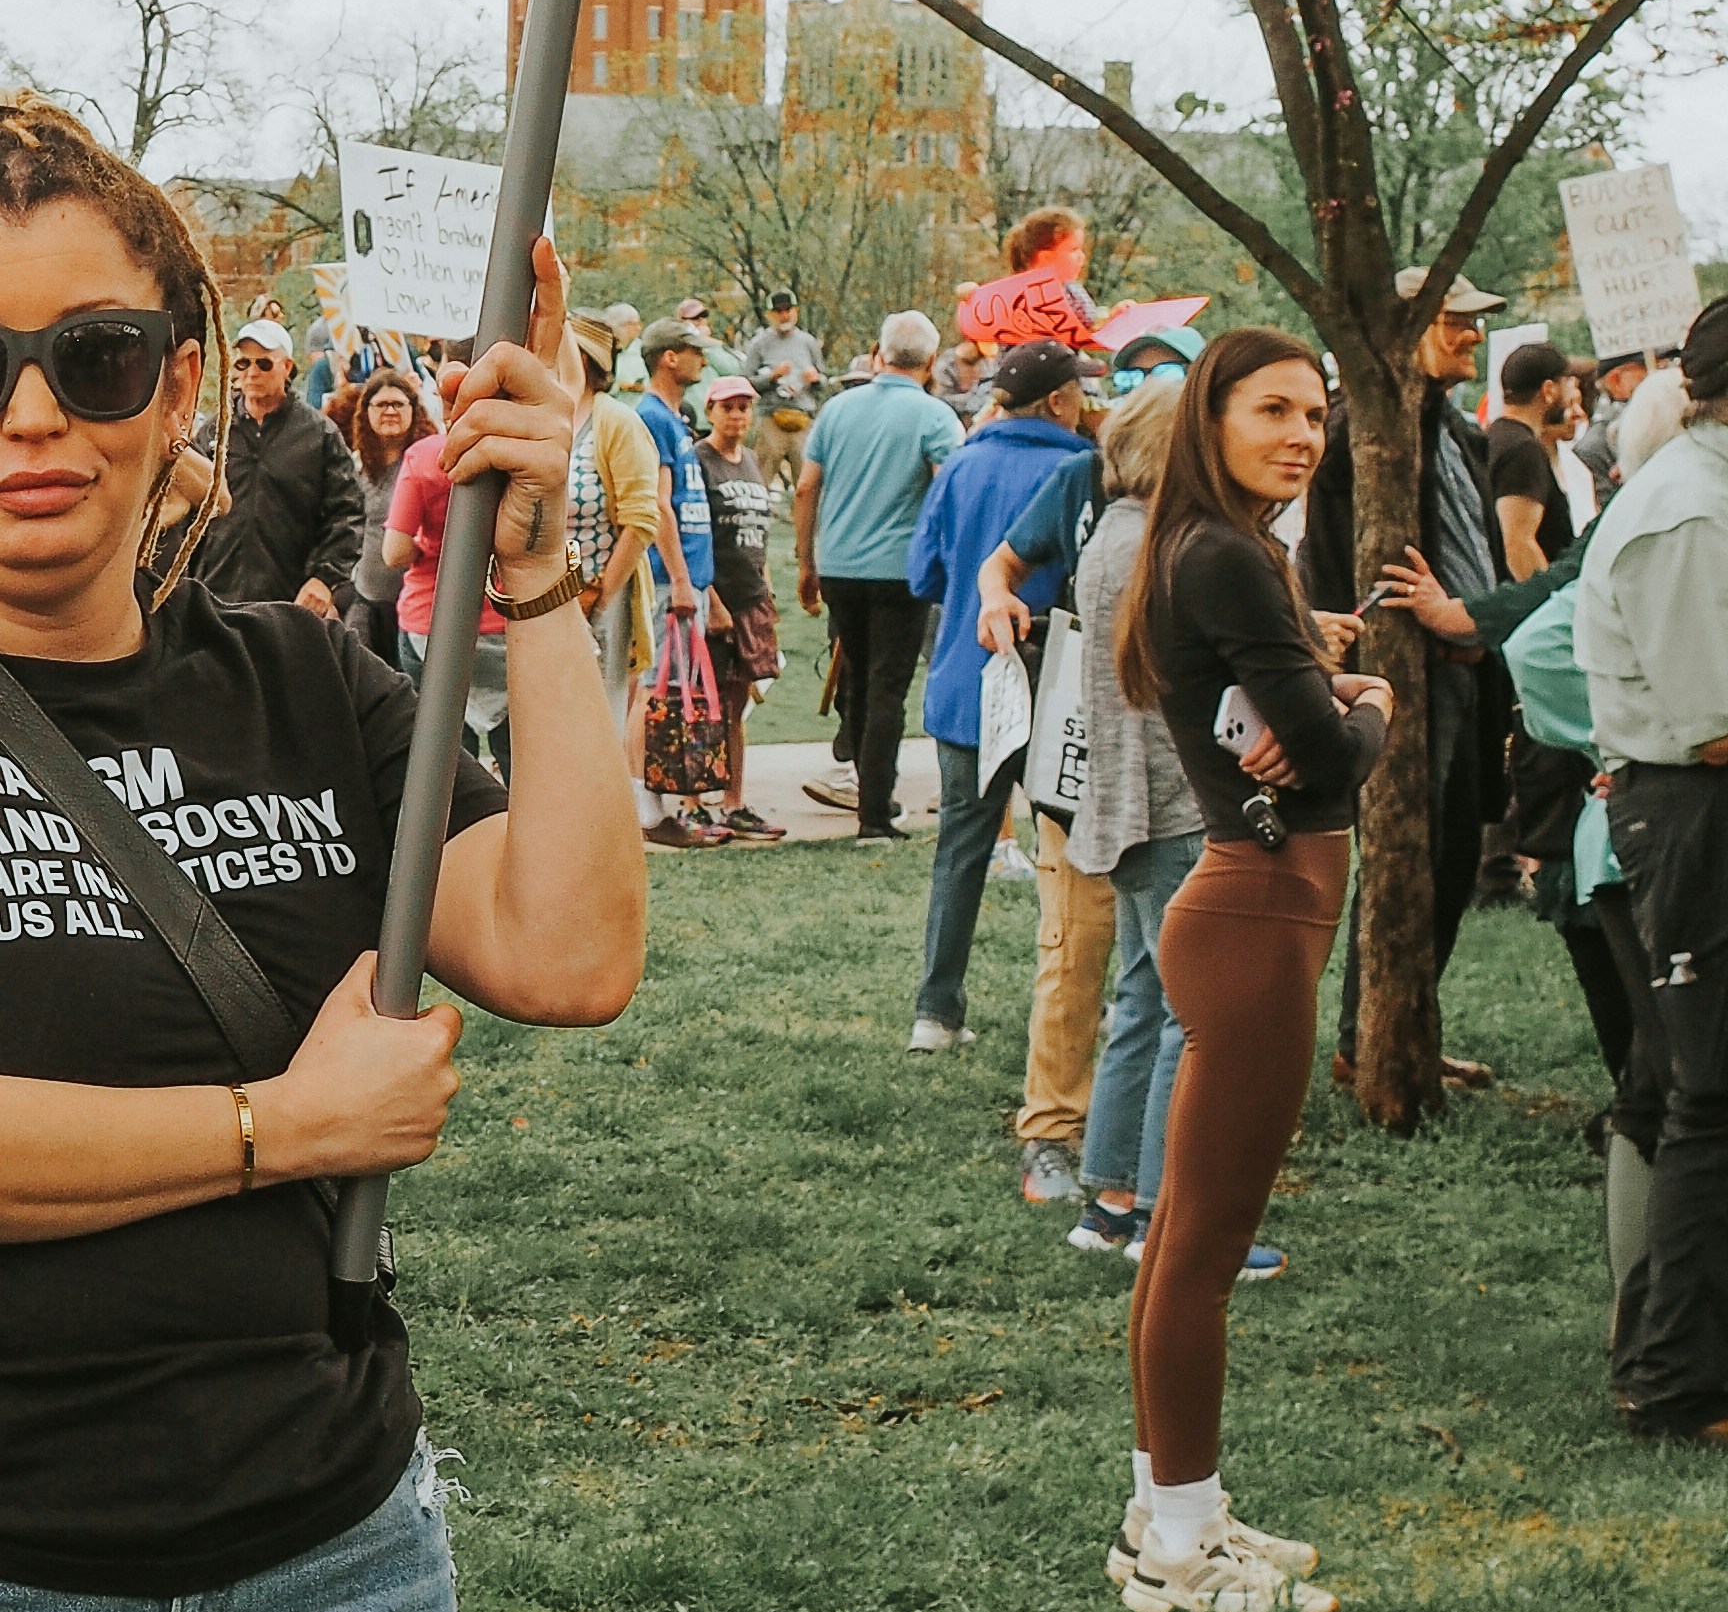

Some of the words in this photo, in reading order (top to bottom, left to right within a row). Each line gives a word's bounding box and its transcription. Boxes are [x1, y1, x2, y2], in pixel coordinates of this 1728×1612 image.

[434, 175, 499, 213] Ameri
[137, 789, 344, 856] SOGYNY
[302, 842, 357, 877] TO
[66, 900, 145, 939] ALL.
